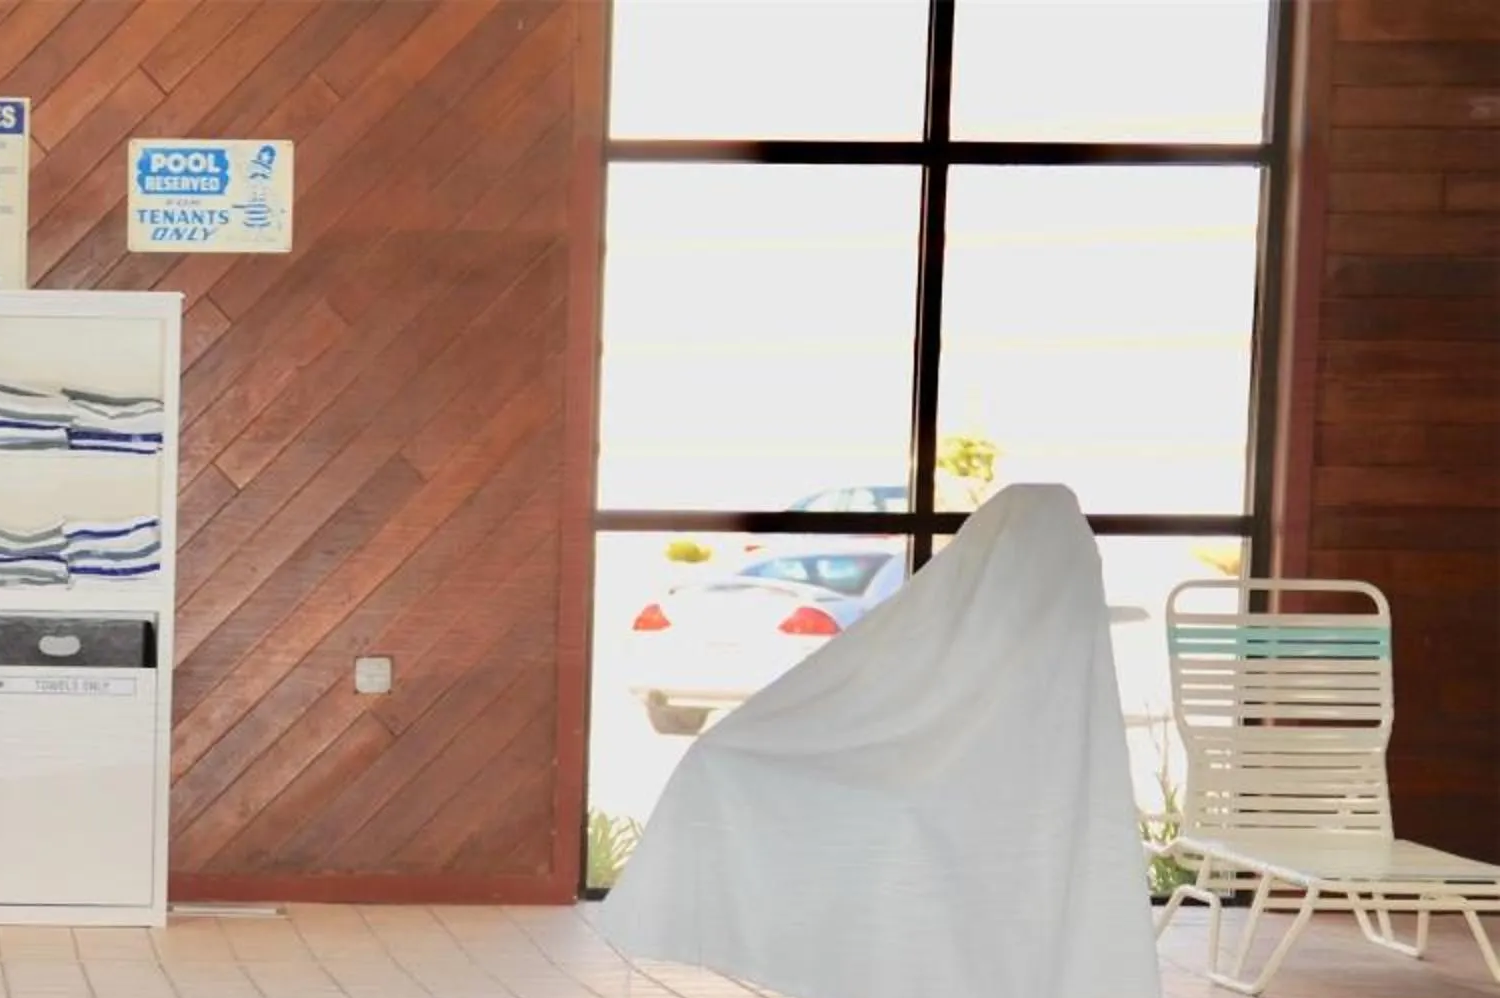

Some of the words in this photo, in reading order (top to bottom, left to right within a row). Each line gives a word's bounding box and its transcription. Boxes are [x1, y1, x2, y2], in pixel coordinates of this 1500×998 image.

[150, 152, 221, 174] POOL
[144, 175, 221, 192] RESERVED
[137, 208, 230, 226] TENANTS
[151, 227, 220, 241] ONLY
